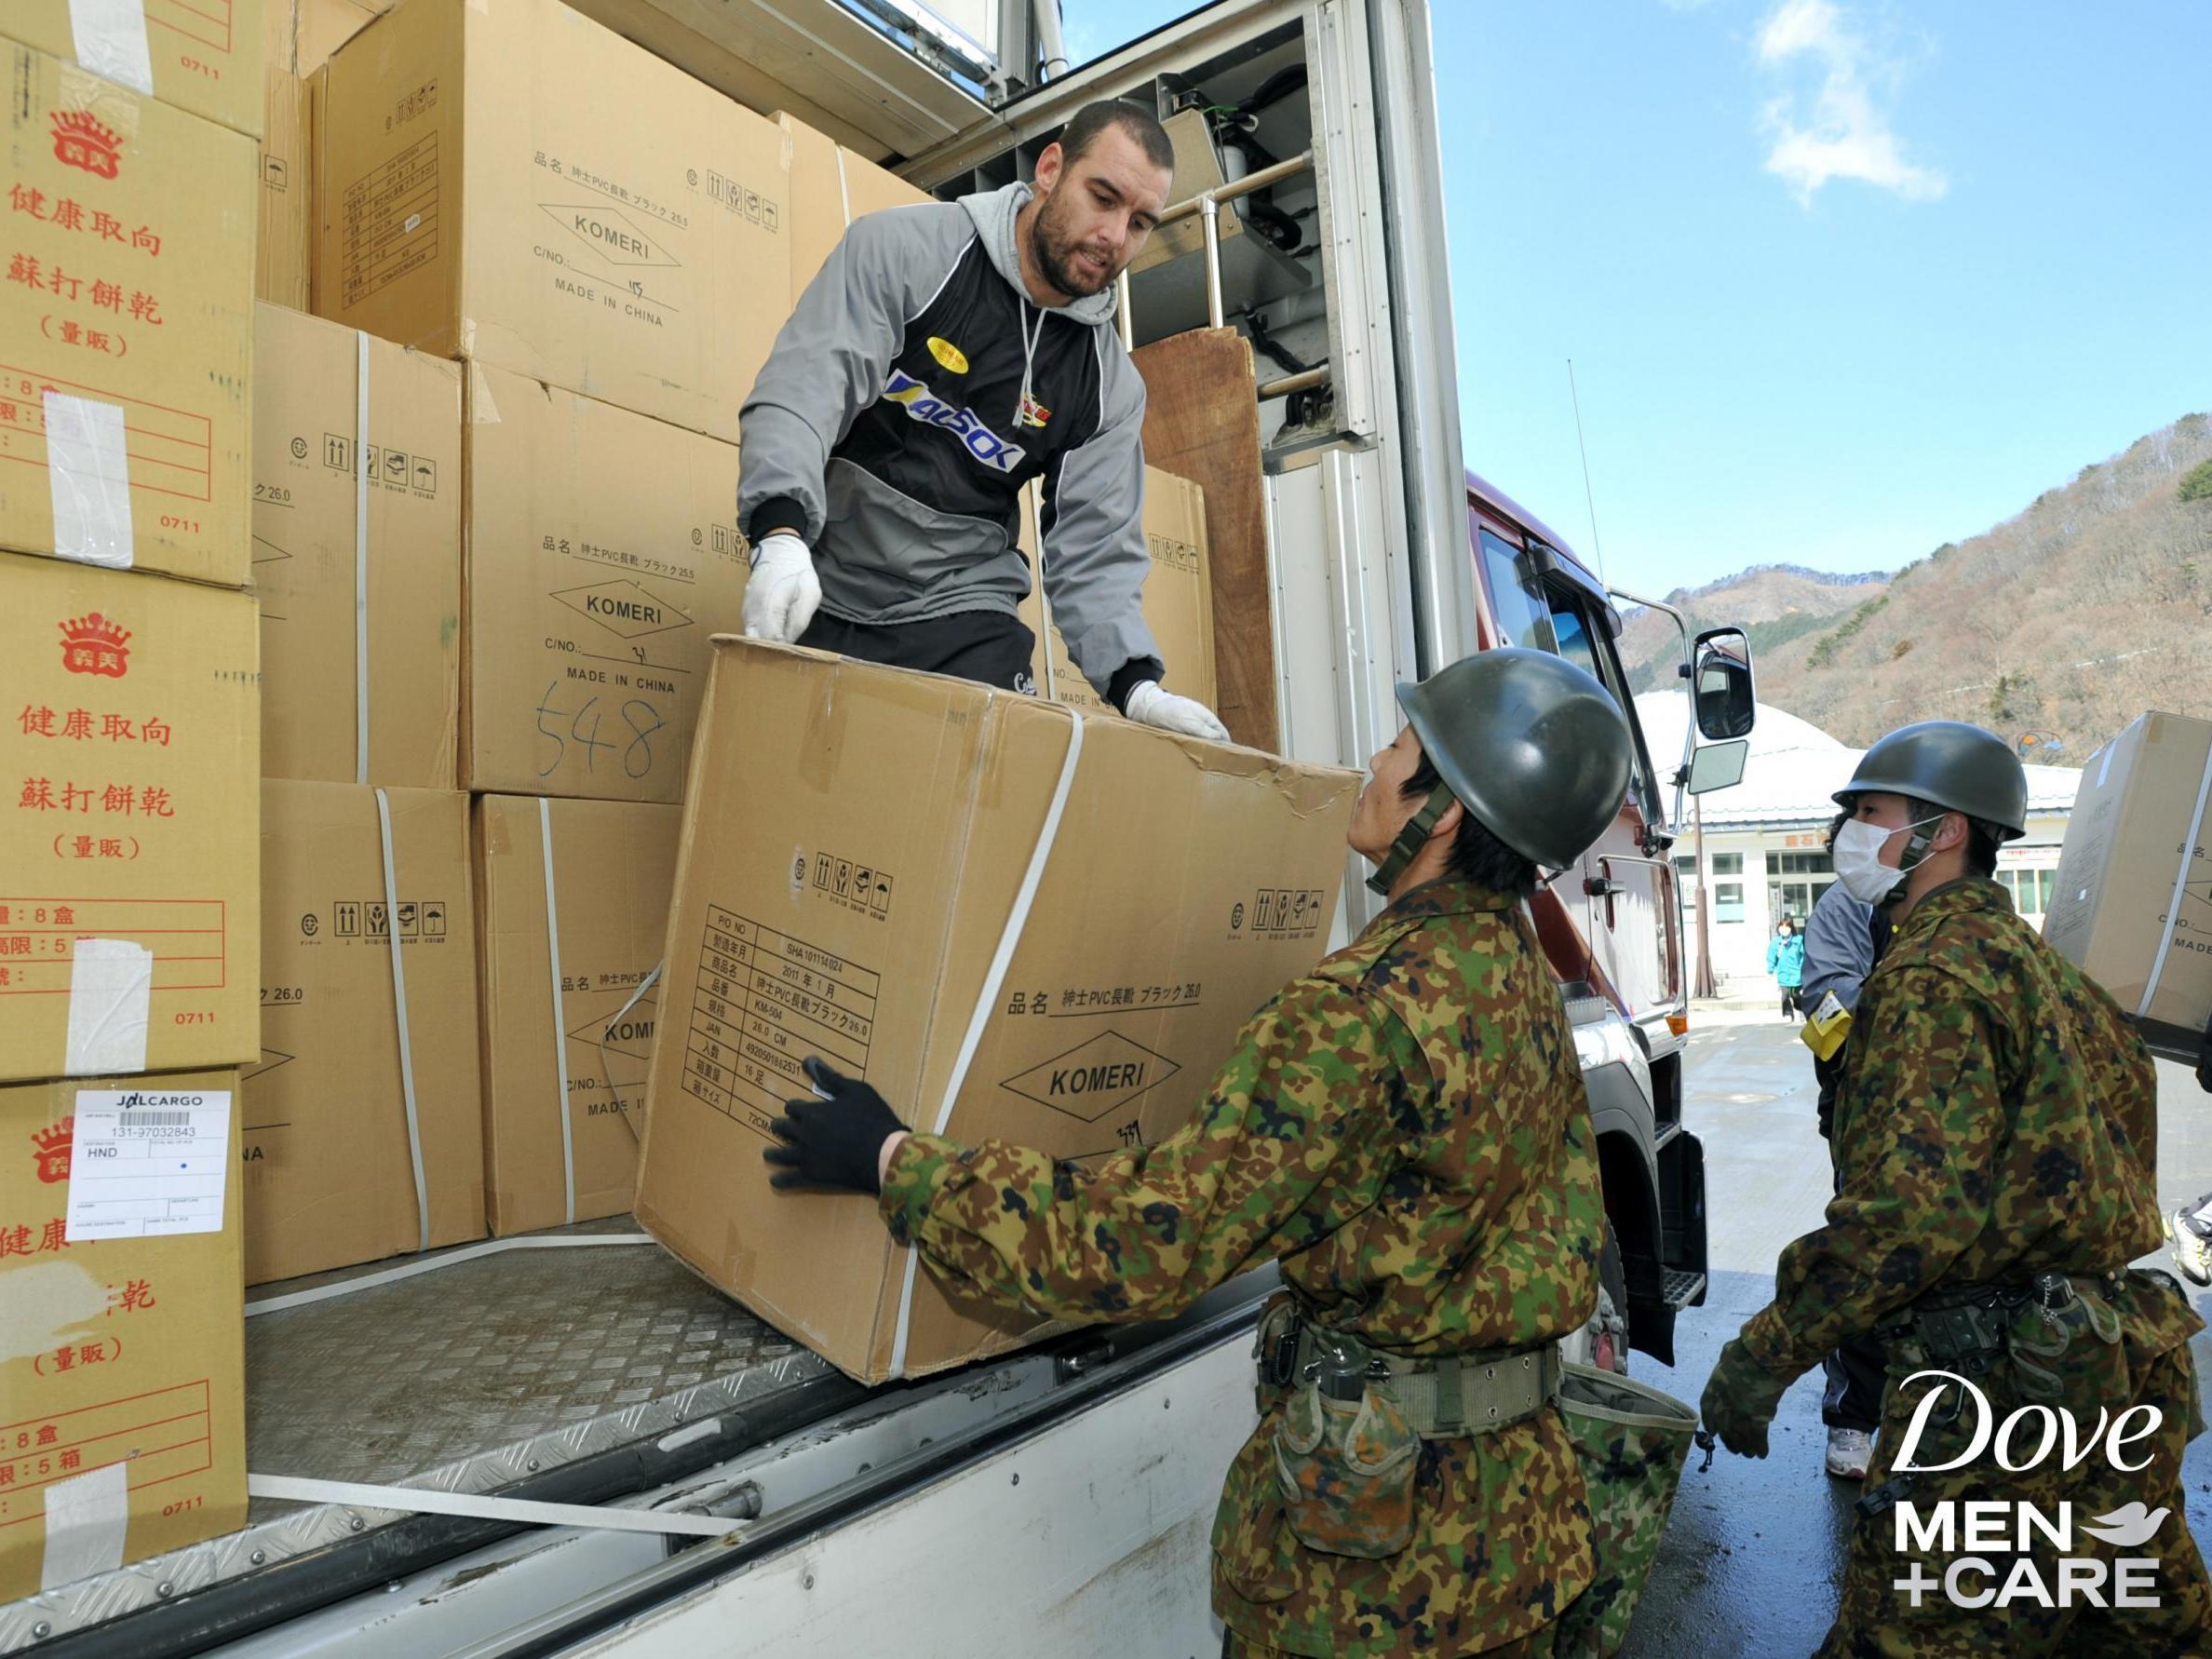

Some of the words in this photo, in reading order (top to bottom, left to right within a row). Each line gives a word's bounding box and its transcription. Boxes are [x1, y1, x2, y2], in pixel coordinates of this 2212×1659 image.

[181, 56, 220, 80] 0711
[534, 151, 561, 174] 品名
[7, 182, 161, 257] 健康取向
[575, 215, 649, 259] KOMERI
[7, 253, 162, 325] 蘇打餅乾
[555, 278, 595, 301] MADE
[604, 295, 616, 309] IN
[625, 303, 663, 328] CHINA
[160, 515, 200, 533] 0711
[543, 535, 571, 554] 品名
[587, 595, 661, 625] KOMERI
[567, 667, 605, 682] MADE
[615, 674, 627, 686] IN
[637, 678, 675, 694] CHINA
[1061, 693, 1086, 705] MADE
[1092, 696, 1099, 708] IN
[17, 705, 171, 747] 健康取向
[536, 681, 667, 777] 548
[18, 777, 175, 817] 蘇打餅乾
[782, 964, 799, 980] 2011
[274, 987, 303, 1000] 26.0
[561, 977, 589, 991] 品名
[1007, 991, 1048, 1015] 品名
[175, 1012, 215, 1025] 0711
[774, 1032, 787, 1048] CM
[1049, 1062, 1145, 1096] KOMERI
[587, 1099, 627, 1116] MADE
[113, 1127, 196, 1138] 131-97032843
[88, 1147, 117, 1158] HND
[163, 1495, 203, 1517] 0711
